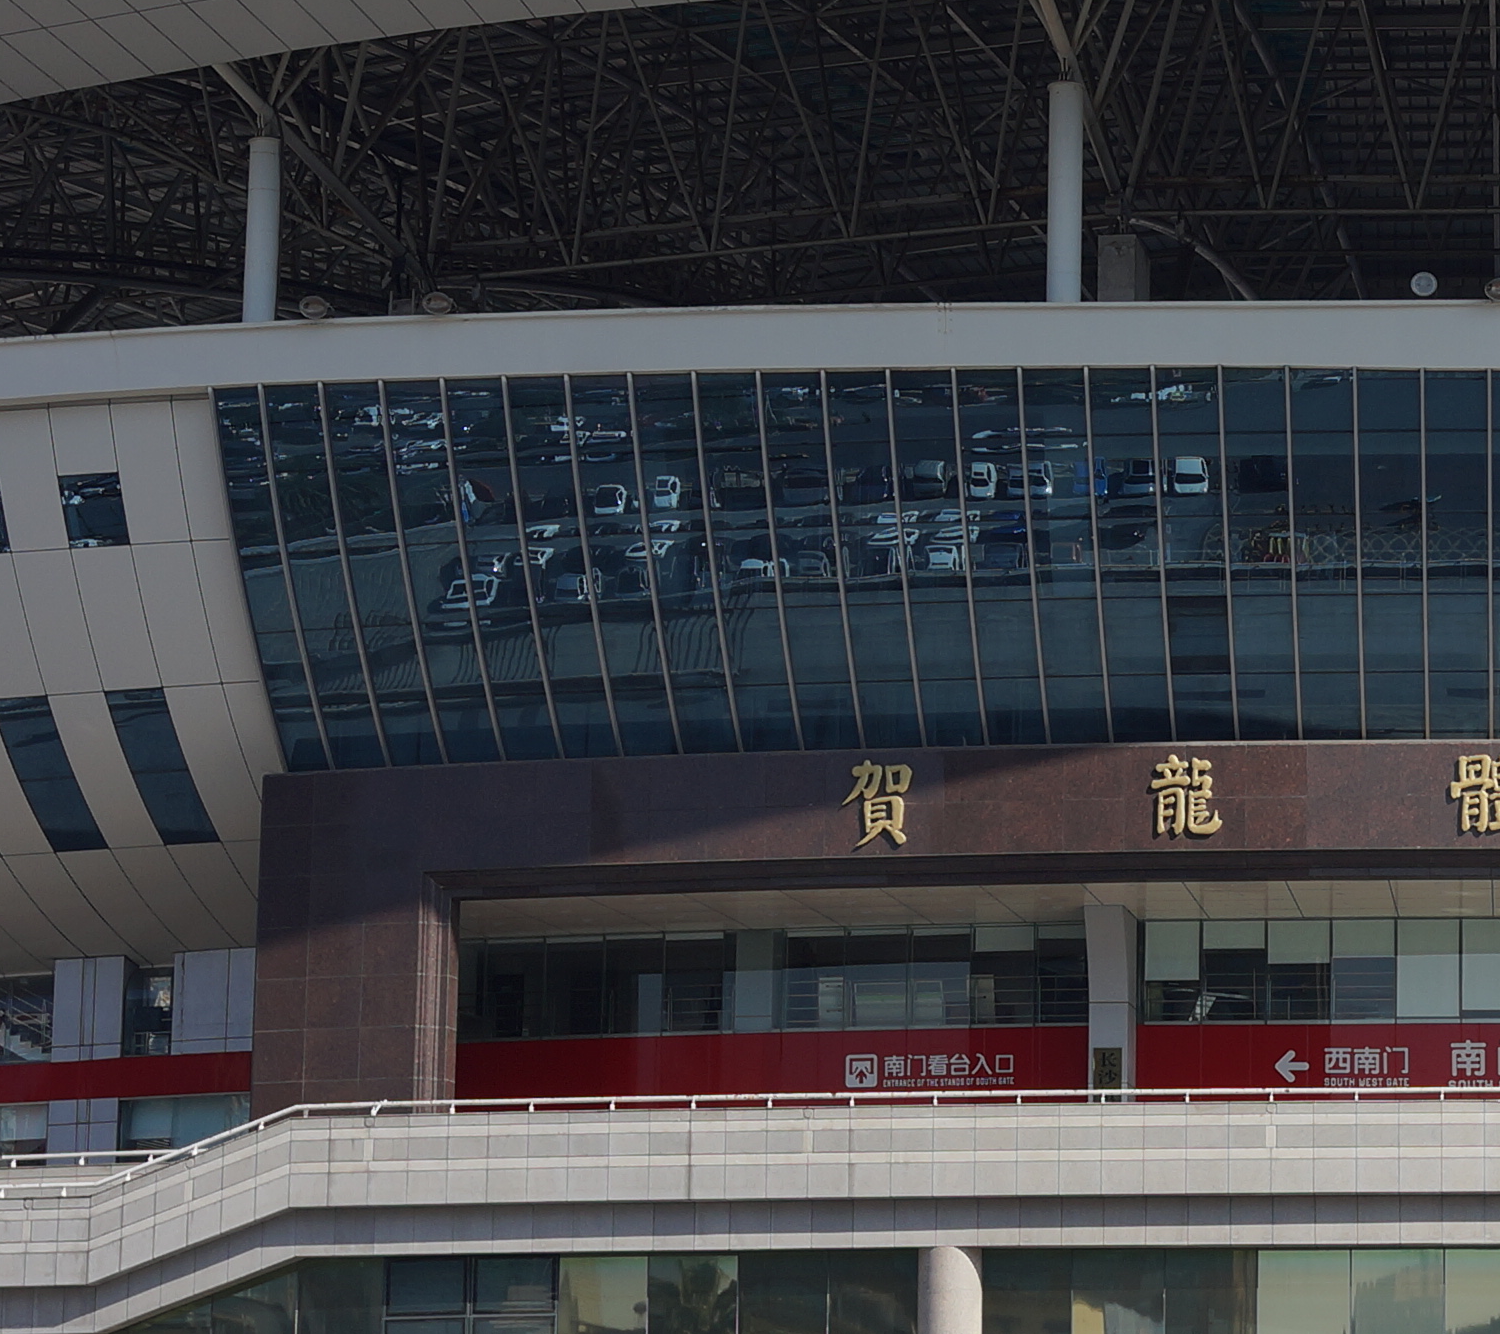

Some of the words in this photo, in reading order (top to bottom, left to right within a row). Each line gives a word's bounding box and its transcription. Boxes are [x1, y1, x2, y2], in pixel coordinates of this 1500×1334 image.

[883, 1054, 1015, 1078] 南门看台入口
[1324, 1047, 1409, 1075] 西南门
[1324, 1078, 1355, 1087] SOUTH
[1358, 1078, 1383, 1087] WEST
[1386, 1078, 1410, 1087] GATE
